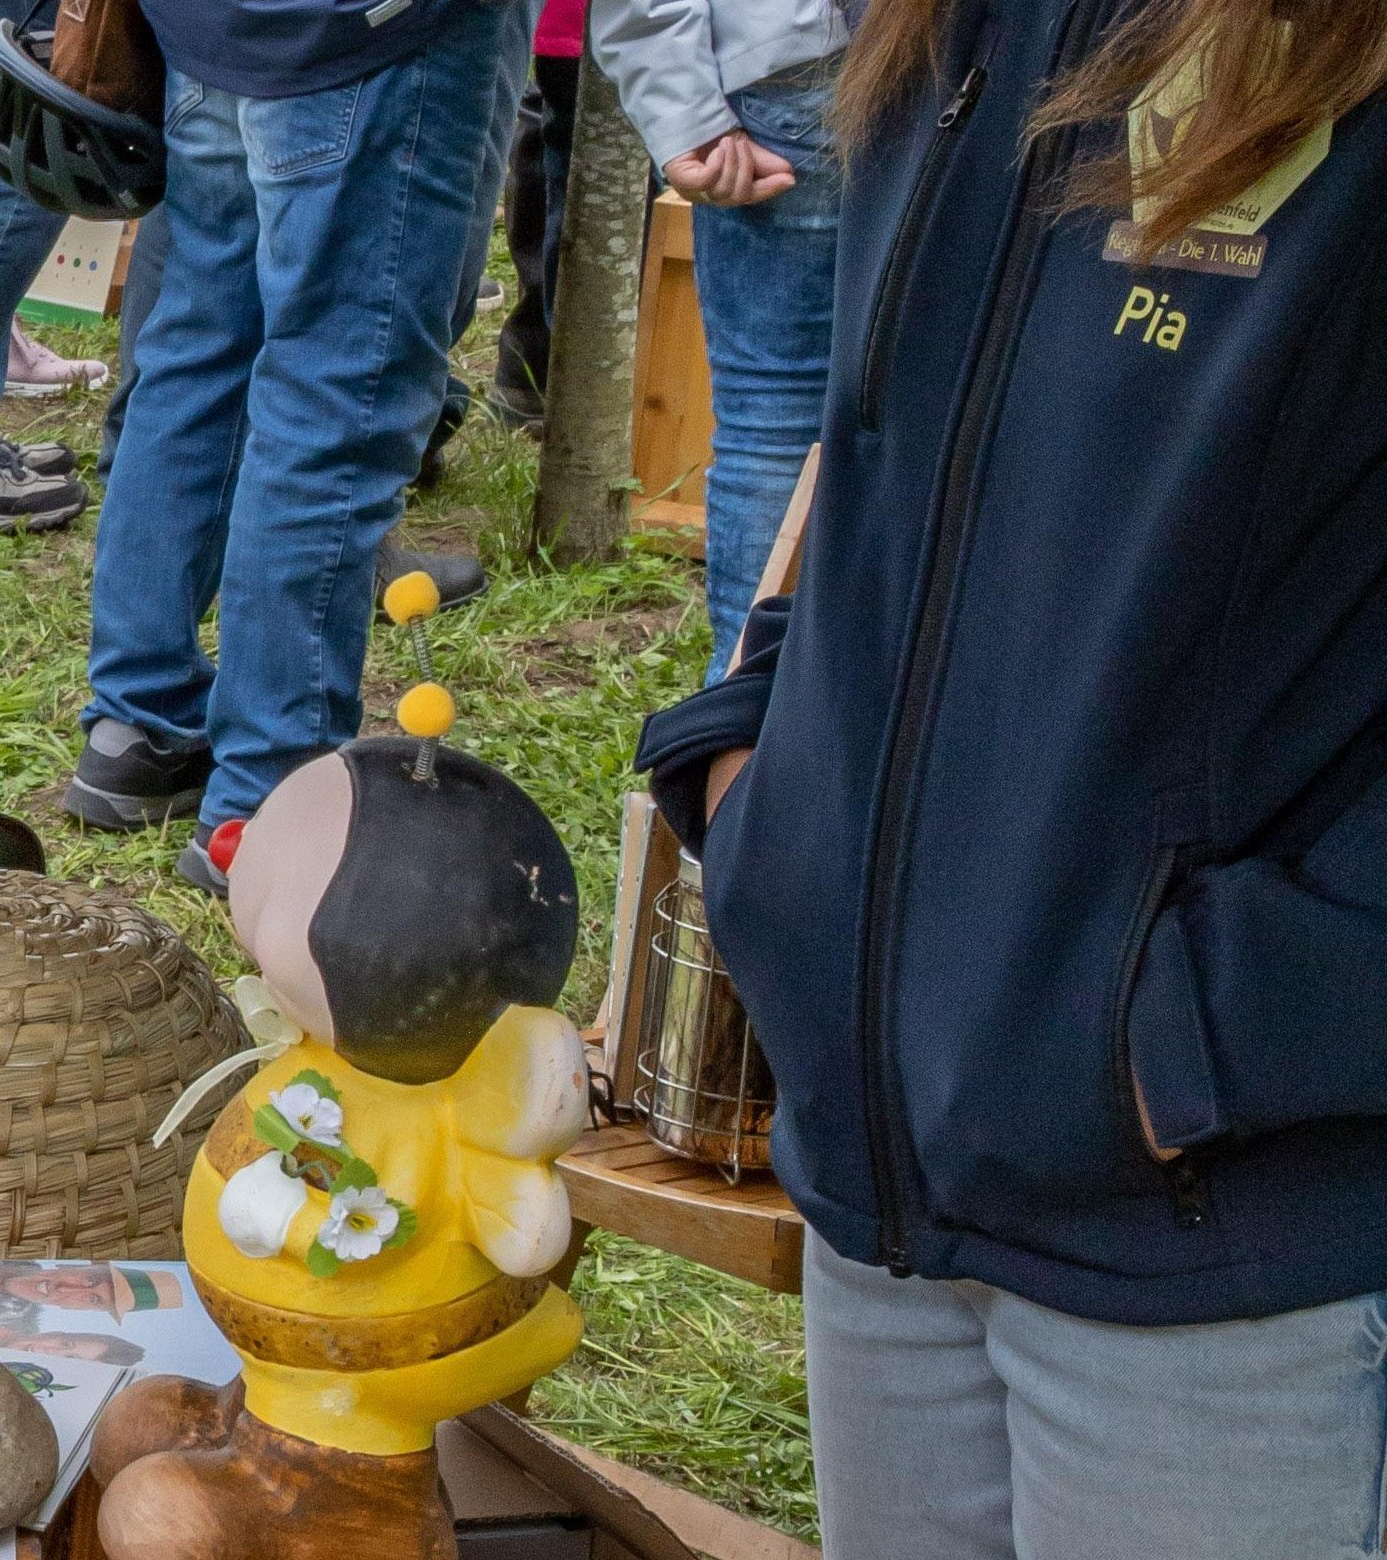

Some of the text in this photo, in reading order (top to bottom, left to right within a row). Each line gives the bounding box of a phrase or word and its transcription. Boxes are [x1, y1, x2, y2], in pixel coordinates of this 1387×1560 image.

[1178, 238, 1206, 261] Die
[1209, 241, 1219, 262] 1.
[1225, 243, 1263, 267] Wahl
[1113, 284, 1189, 353] Pia
